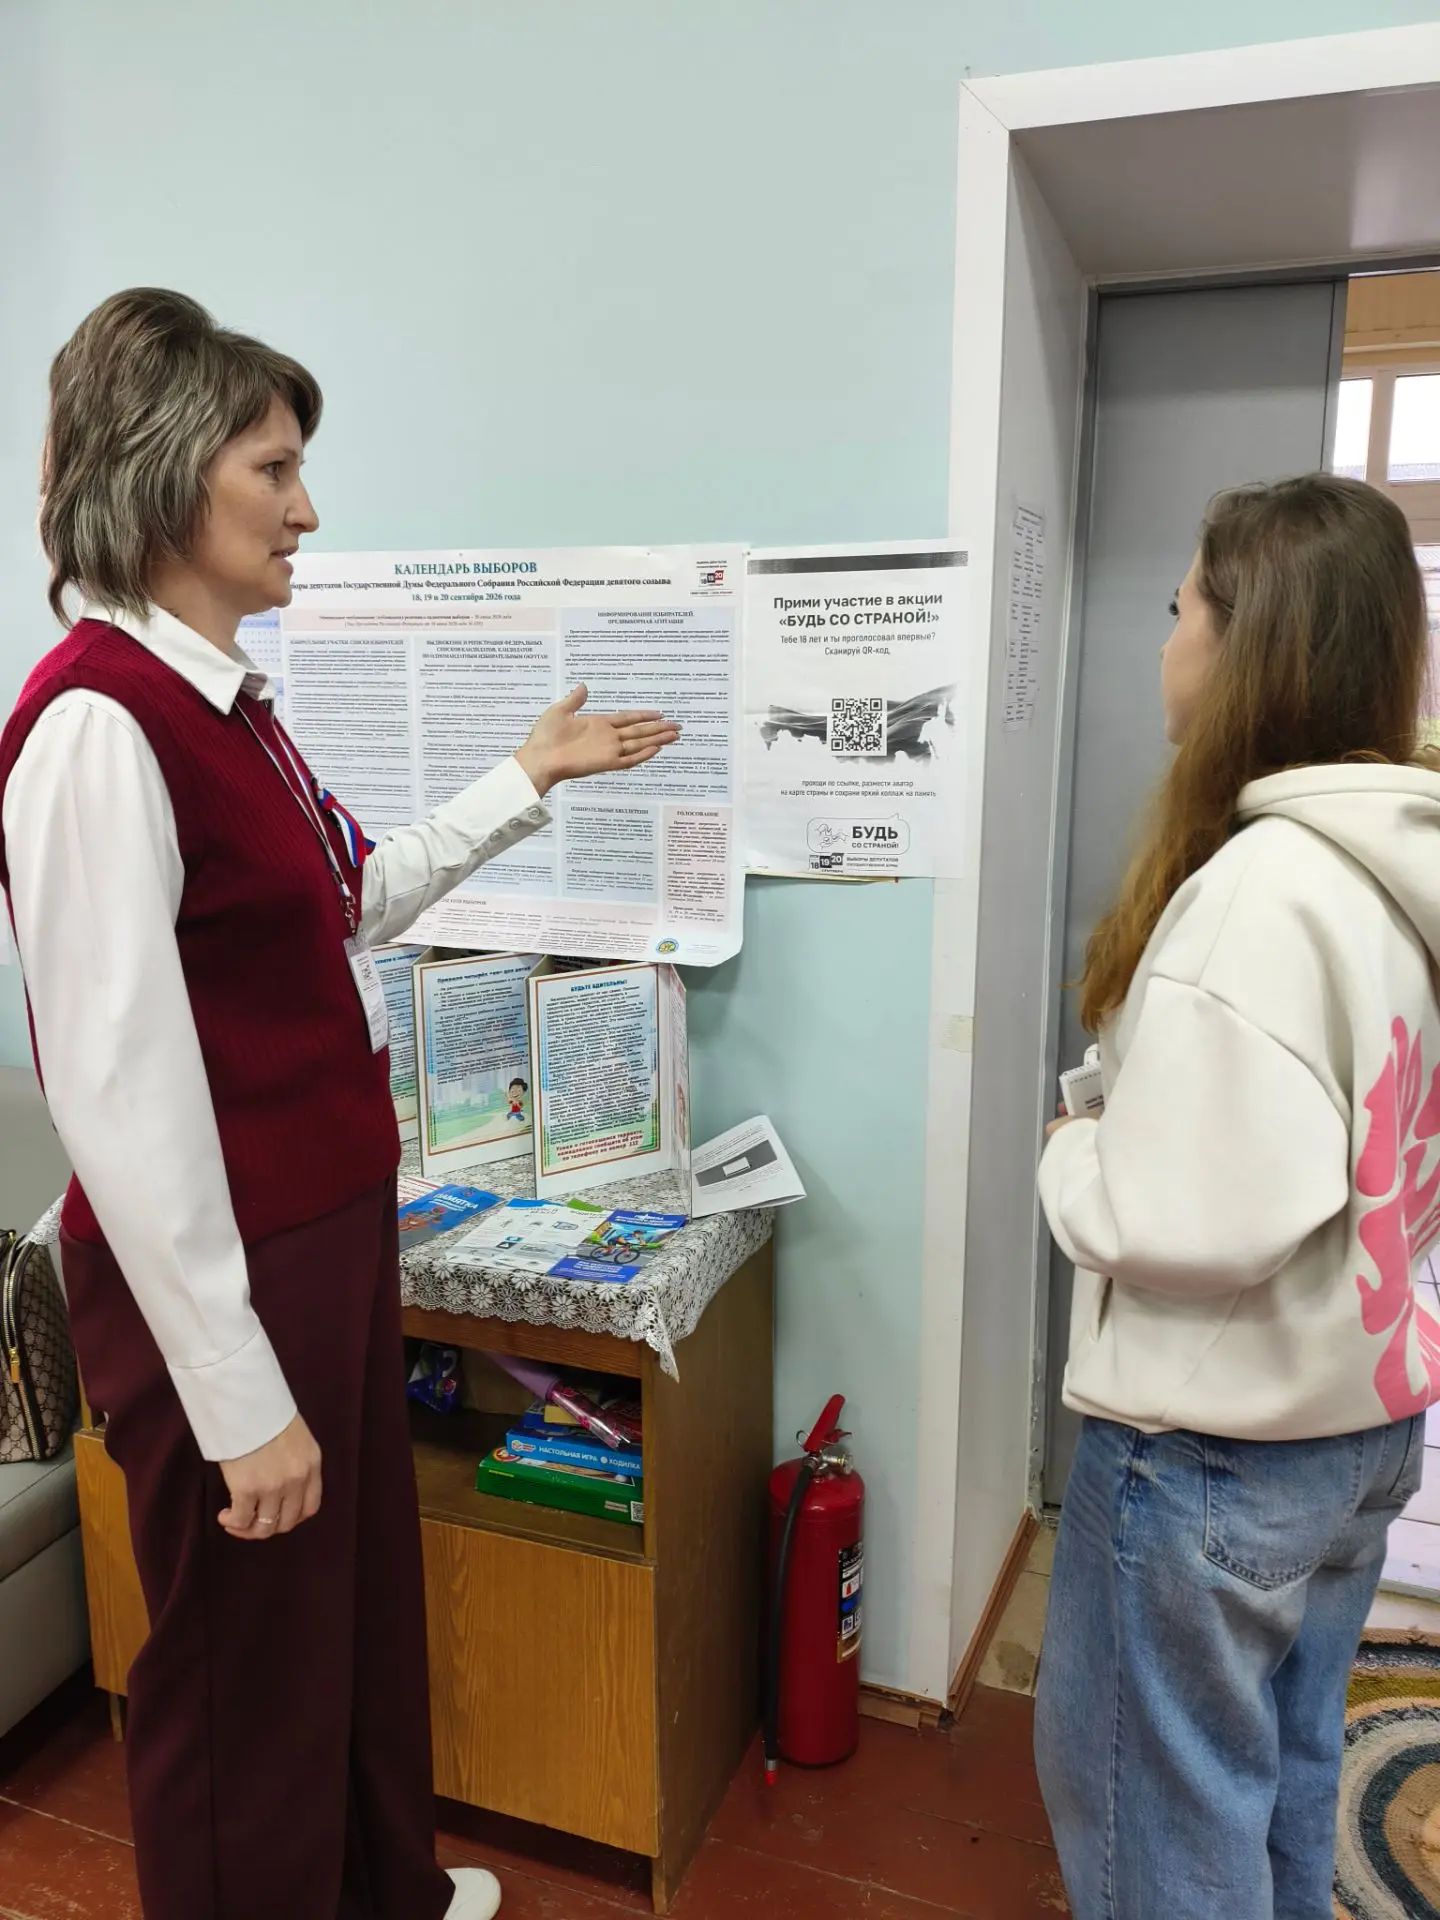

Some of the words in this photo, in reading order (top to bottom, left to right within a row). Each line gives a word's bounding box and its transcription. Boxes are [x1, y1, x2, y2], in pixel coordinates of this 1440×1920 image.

[394, 563, 470, 576] КАЛЕНДАРЬ
[473, 561, 538, 574] ВЫБОРОВ
[291, 580, 309, 591] боры
[309, 582, 342, 591] депутатов
[343, 580, 401, 590] Государственной
[402, 580, 423, 589] Думы
[425, 579, 475, 589] Федерального
[477, 578, 515, 589] Собрания
[517, 578, 561, 588] Российской
[562, 577, 605, 588] Федерации
[606, 578, 641, 587] девятого
[412, 593, 422, 602] 18,
[424, 593, 432, 601] 19
[440, 593, 449, 601] 20
[450, 593, 483, 603] сентября
[485, 592, 503, 601] 2026
[773, 597, 821, 610] Прими
[823, 595, 882, 610] участие
[885, 596, 894, 606] в
[897, 593, 943, 606] акции
[779, 614, 826, 628] «БУДЬ
[829, 613, 850, 626] СО
[854, 609, 939, 625] СТРАНОЙ!»
[781, 635, 798, 644] Тебе
[799, 635, 807, 643] 18
[842, 634, 895, 644] проголосовал
[896, 632, 936, 642] впервые?
[824, 646, 861, 656] Сканируй
[836, 780, 860, 788] ссылке,
[861, 780, 891, 788] размести
[788, 789, 806, 797] карте
[806, 789, 829, 797] страны
[835, 789, 860, 797] сохрани
[851, 826, 899, 842] БУДЬ
[862, 841, 899, 849] СТРАНОЙ!
[810, 861, 820, 870] 18
[820, 857, 830, 867] 19
[831, 855, 842, 864] 20
[570, 983, 591, 993] БУДЬТЕ
[538, 1446, 581, 1459] НАСТОЛЬНАЯ
[581, 1453, 599, 1462] ИГРА
